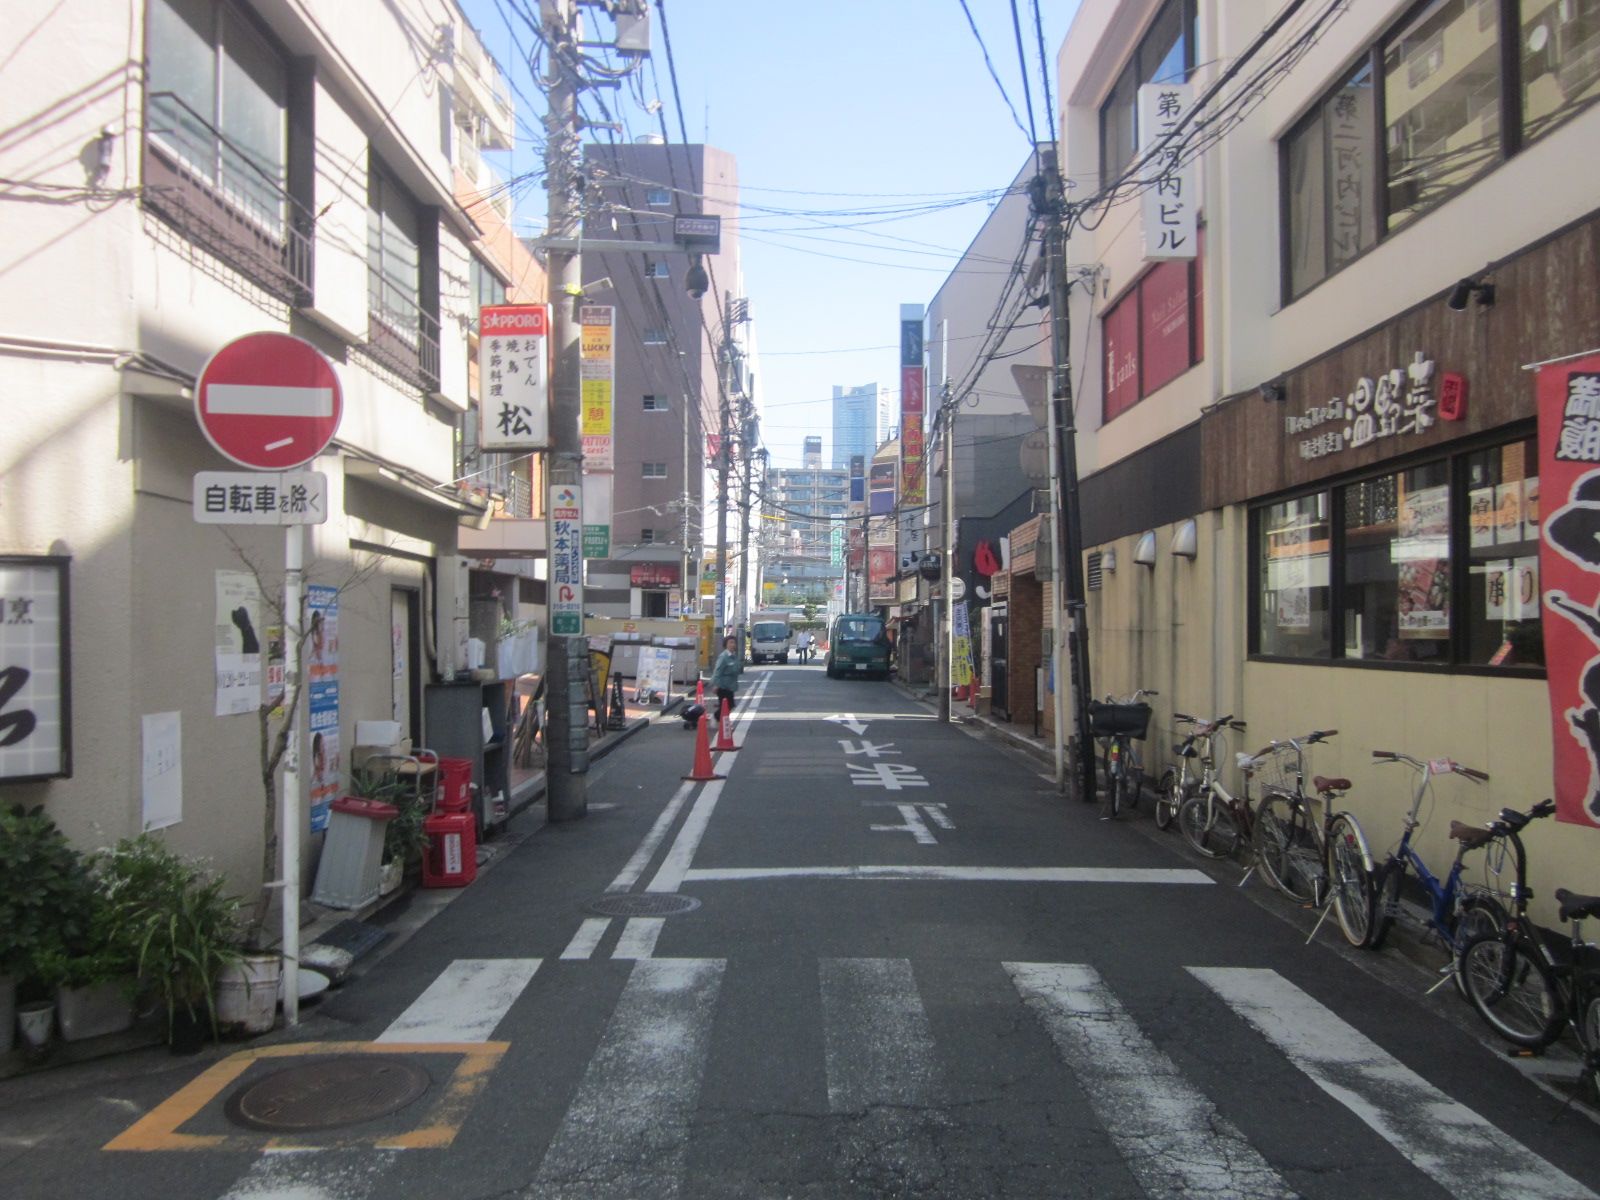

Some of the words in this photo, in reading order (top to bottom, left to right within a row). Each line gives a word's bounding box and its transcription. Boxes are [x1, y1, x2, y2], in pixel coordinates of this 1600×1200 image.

[1155, 91, 1187, 250] 第二河内ビル
[489, 339, 503, 397] 季節料理
[582, 344, 610, 352] LUCKY
[496, 402, 532, 437] 松
[205, 485, 319, 514] 自転車を除く
[554, 521, 570, 584] 秋本薬局
